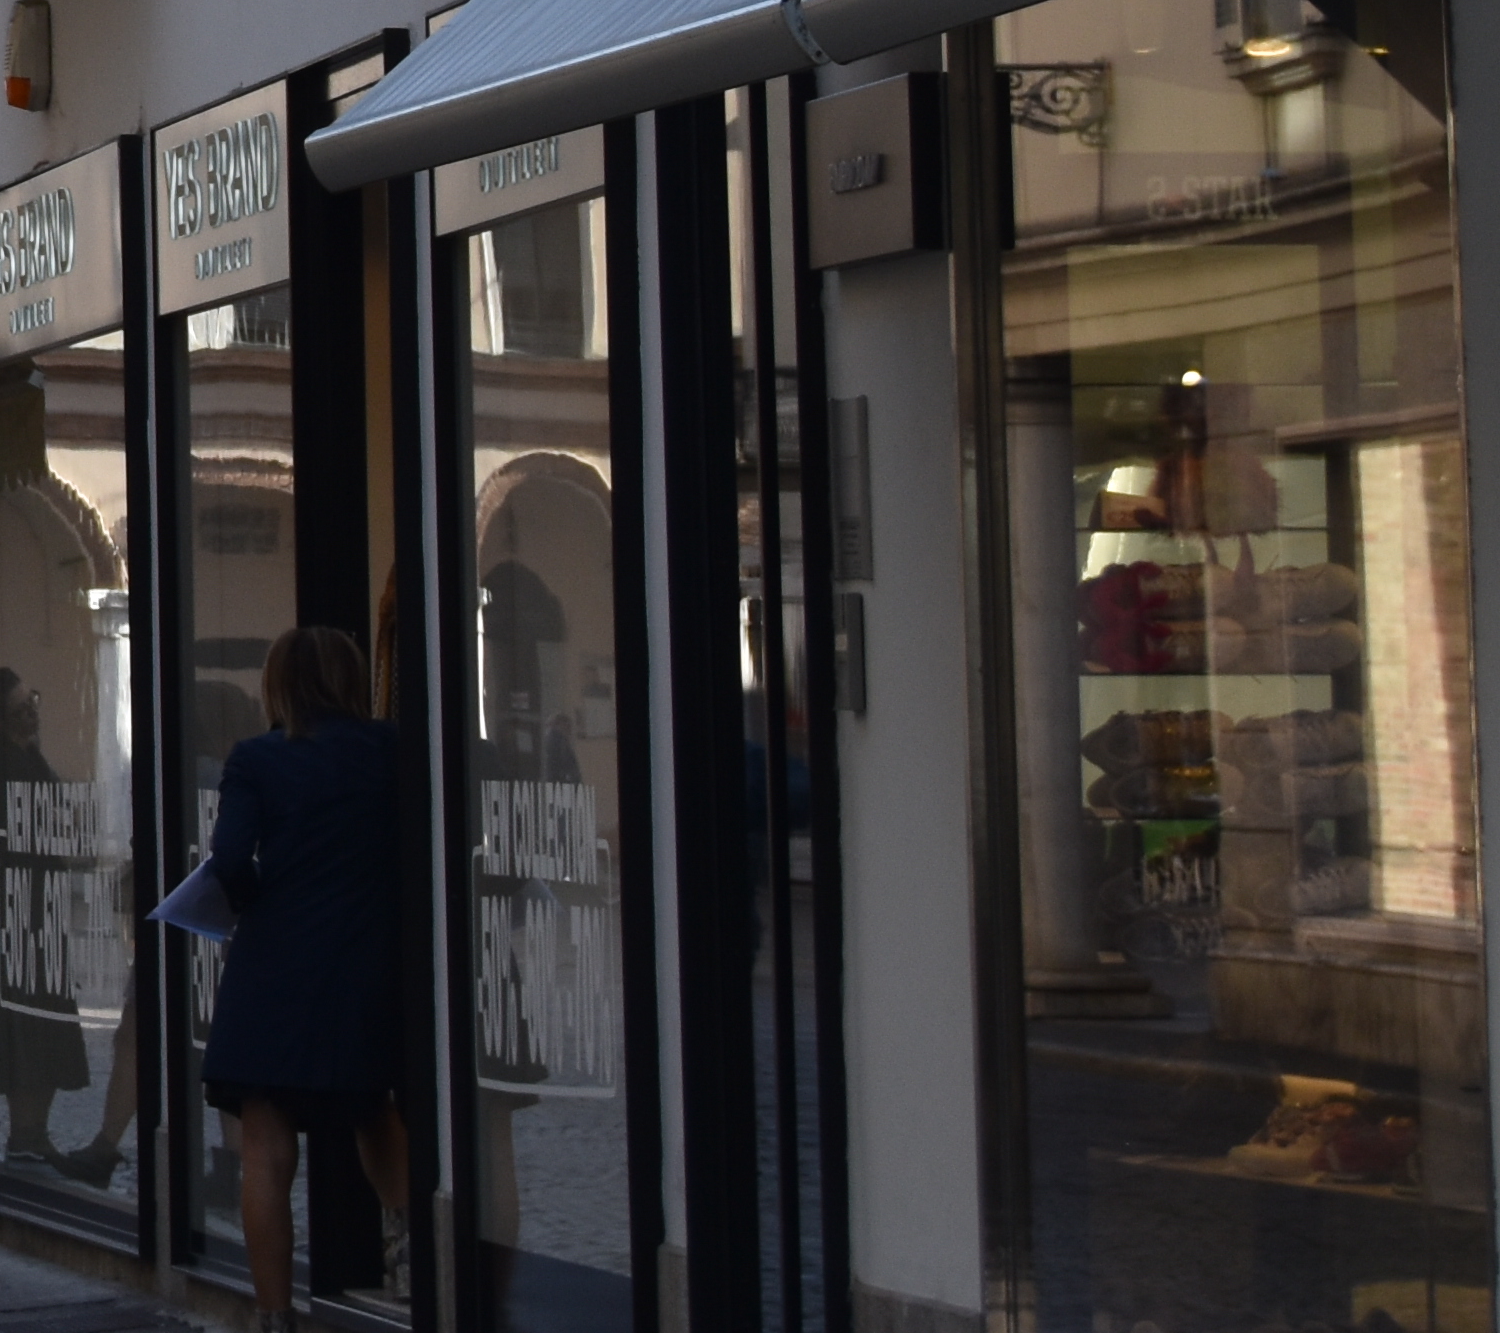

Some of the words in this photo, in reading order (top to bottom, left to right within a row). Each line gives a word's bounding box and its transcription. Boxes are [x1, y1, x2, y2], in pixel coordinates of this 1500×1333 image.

[163, 138, 203, 240] YES
[205, 111, 279, 229] BRAND
[479, 136, 560, 193] OUTLET
[17, 186, 76, 288] BRAND
[195, 237, 253, 281] OUTLET
[9, 296, 55, 334] OUTLET
[7, 781, 32, 853] NEW
[34, 781, 107, 858] COLLECTIO
[198, 788, 221, 856] NE
[481, 780, 510, 875] NEW
[513, 780, 597, 884] COLLECTION
[1, 866, 37, 995] -50%
[478, 895, 517, 1065] -50%
[521, 898, 563, 1074] -60%
[567, 905, 612, 1084] -70%
